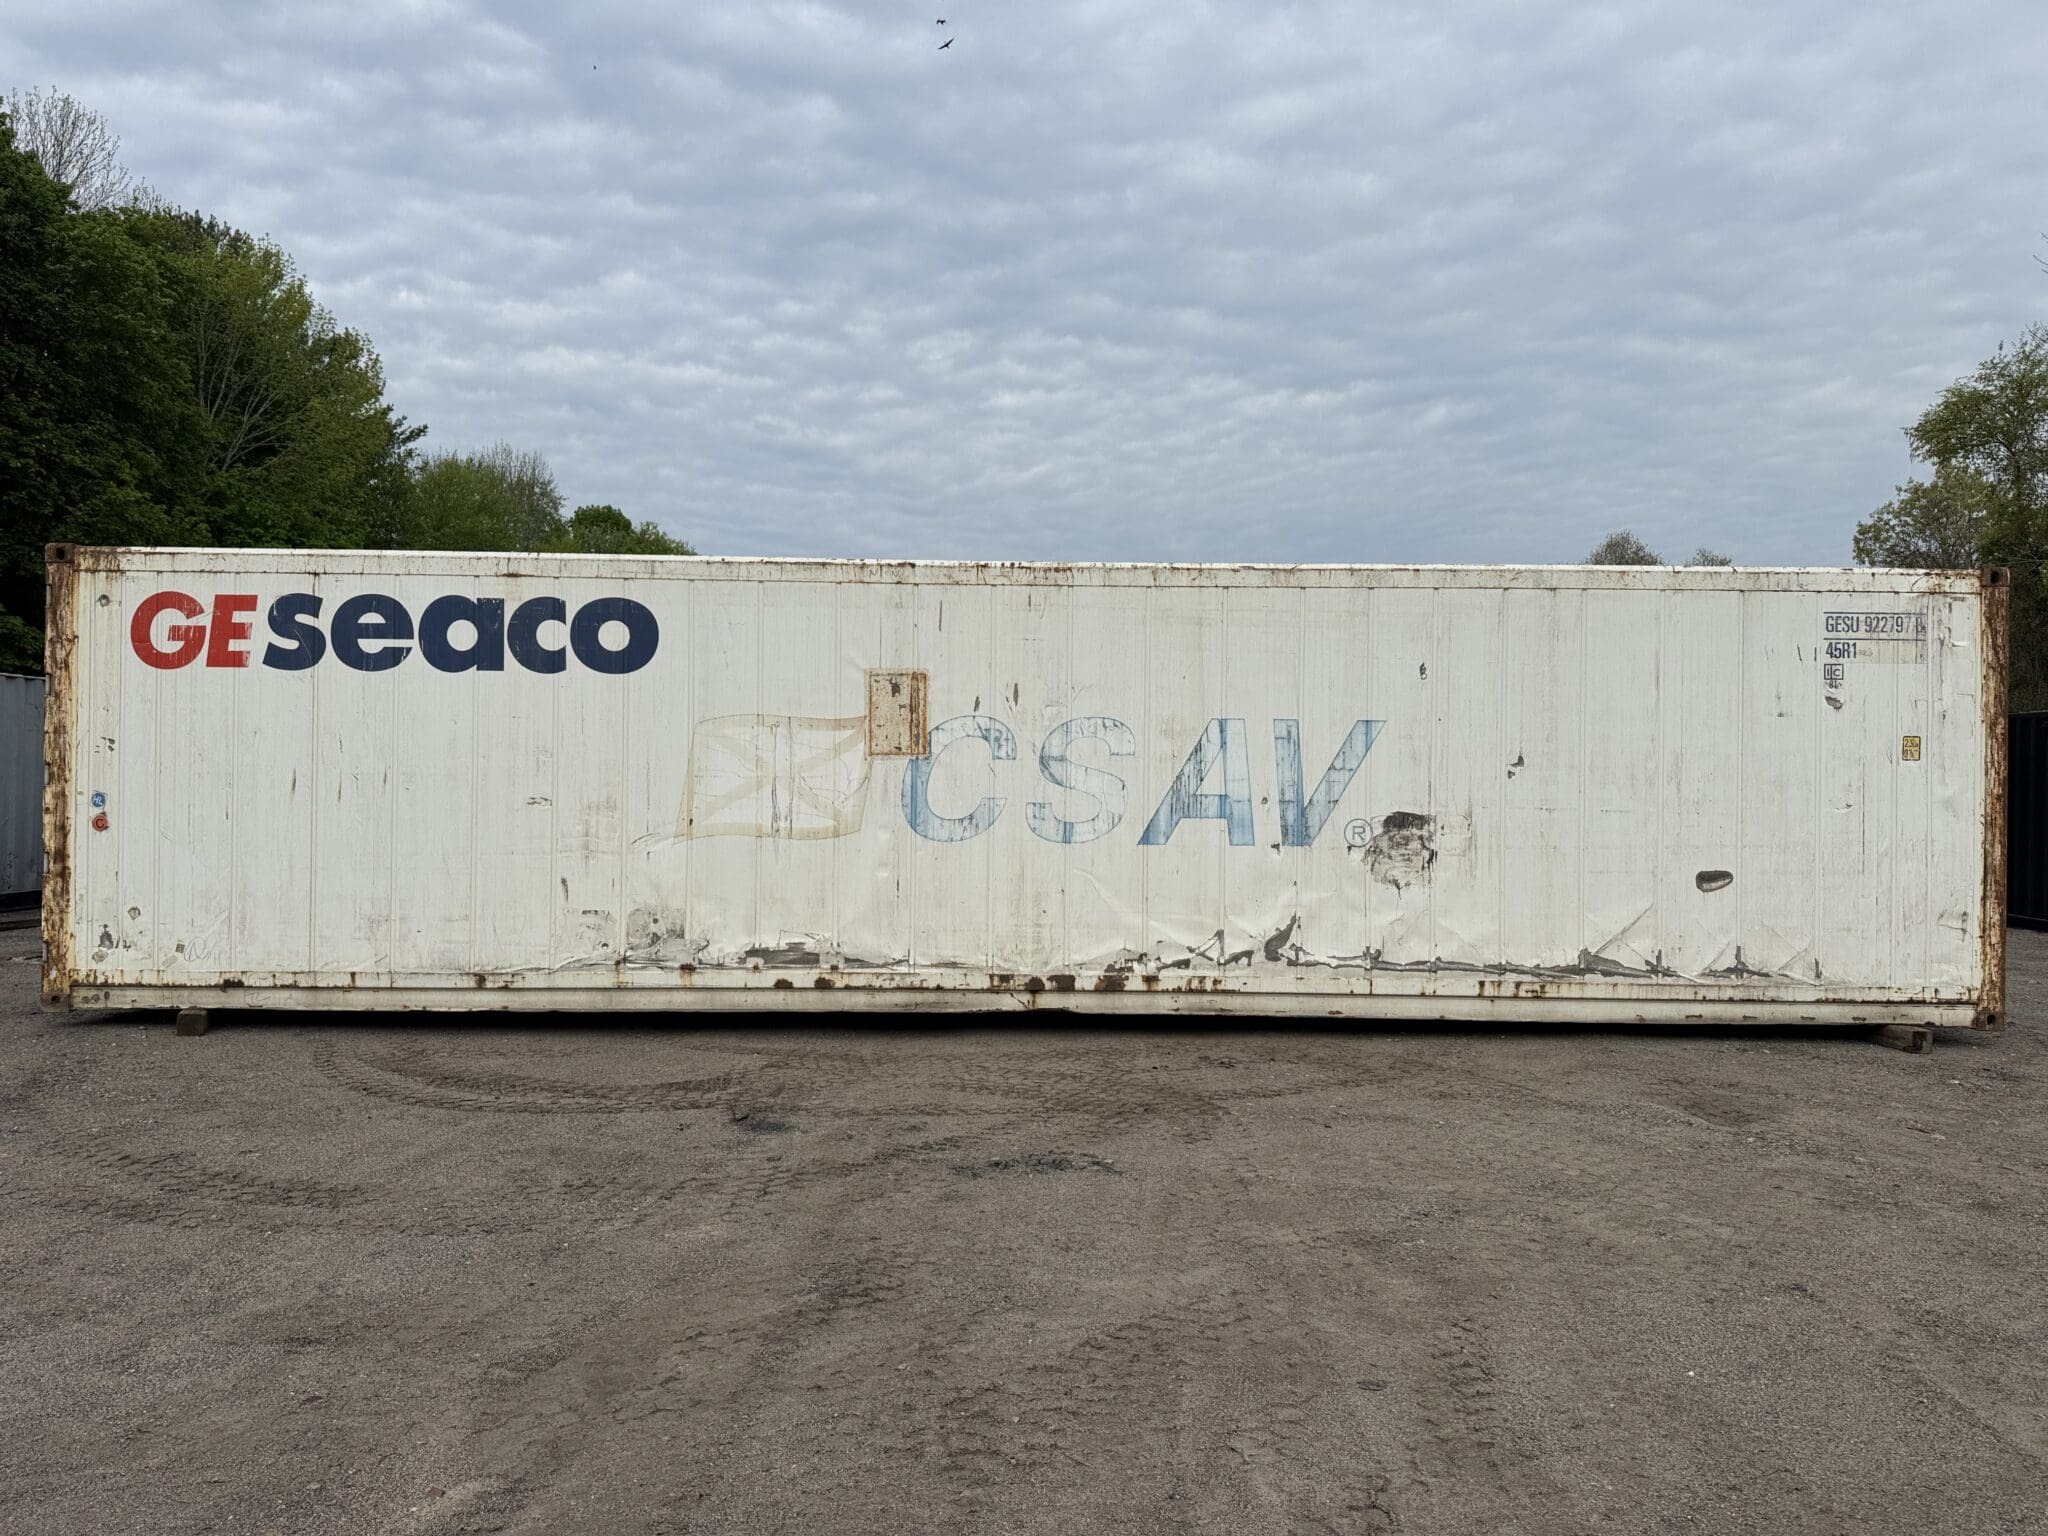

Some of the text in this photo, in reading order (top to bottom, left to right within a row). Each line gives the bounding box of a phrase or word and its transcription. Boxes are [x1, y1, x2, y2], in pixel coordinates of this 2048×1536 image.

[1825, 615, 1860, 633] GESU
[1825, 641, 1857, 659] 45R1
[901, 715, 1387, 847] CSAV
[96, 818, 104, 828] C
